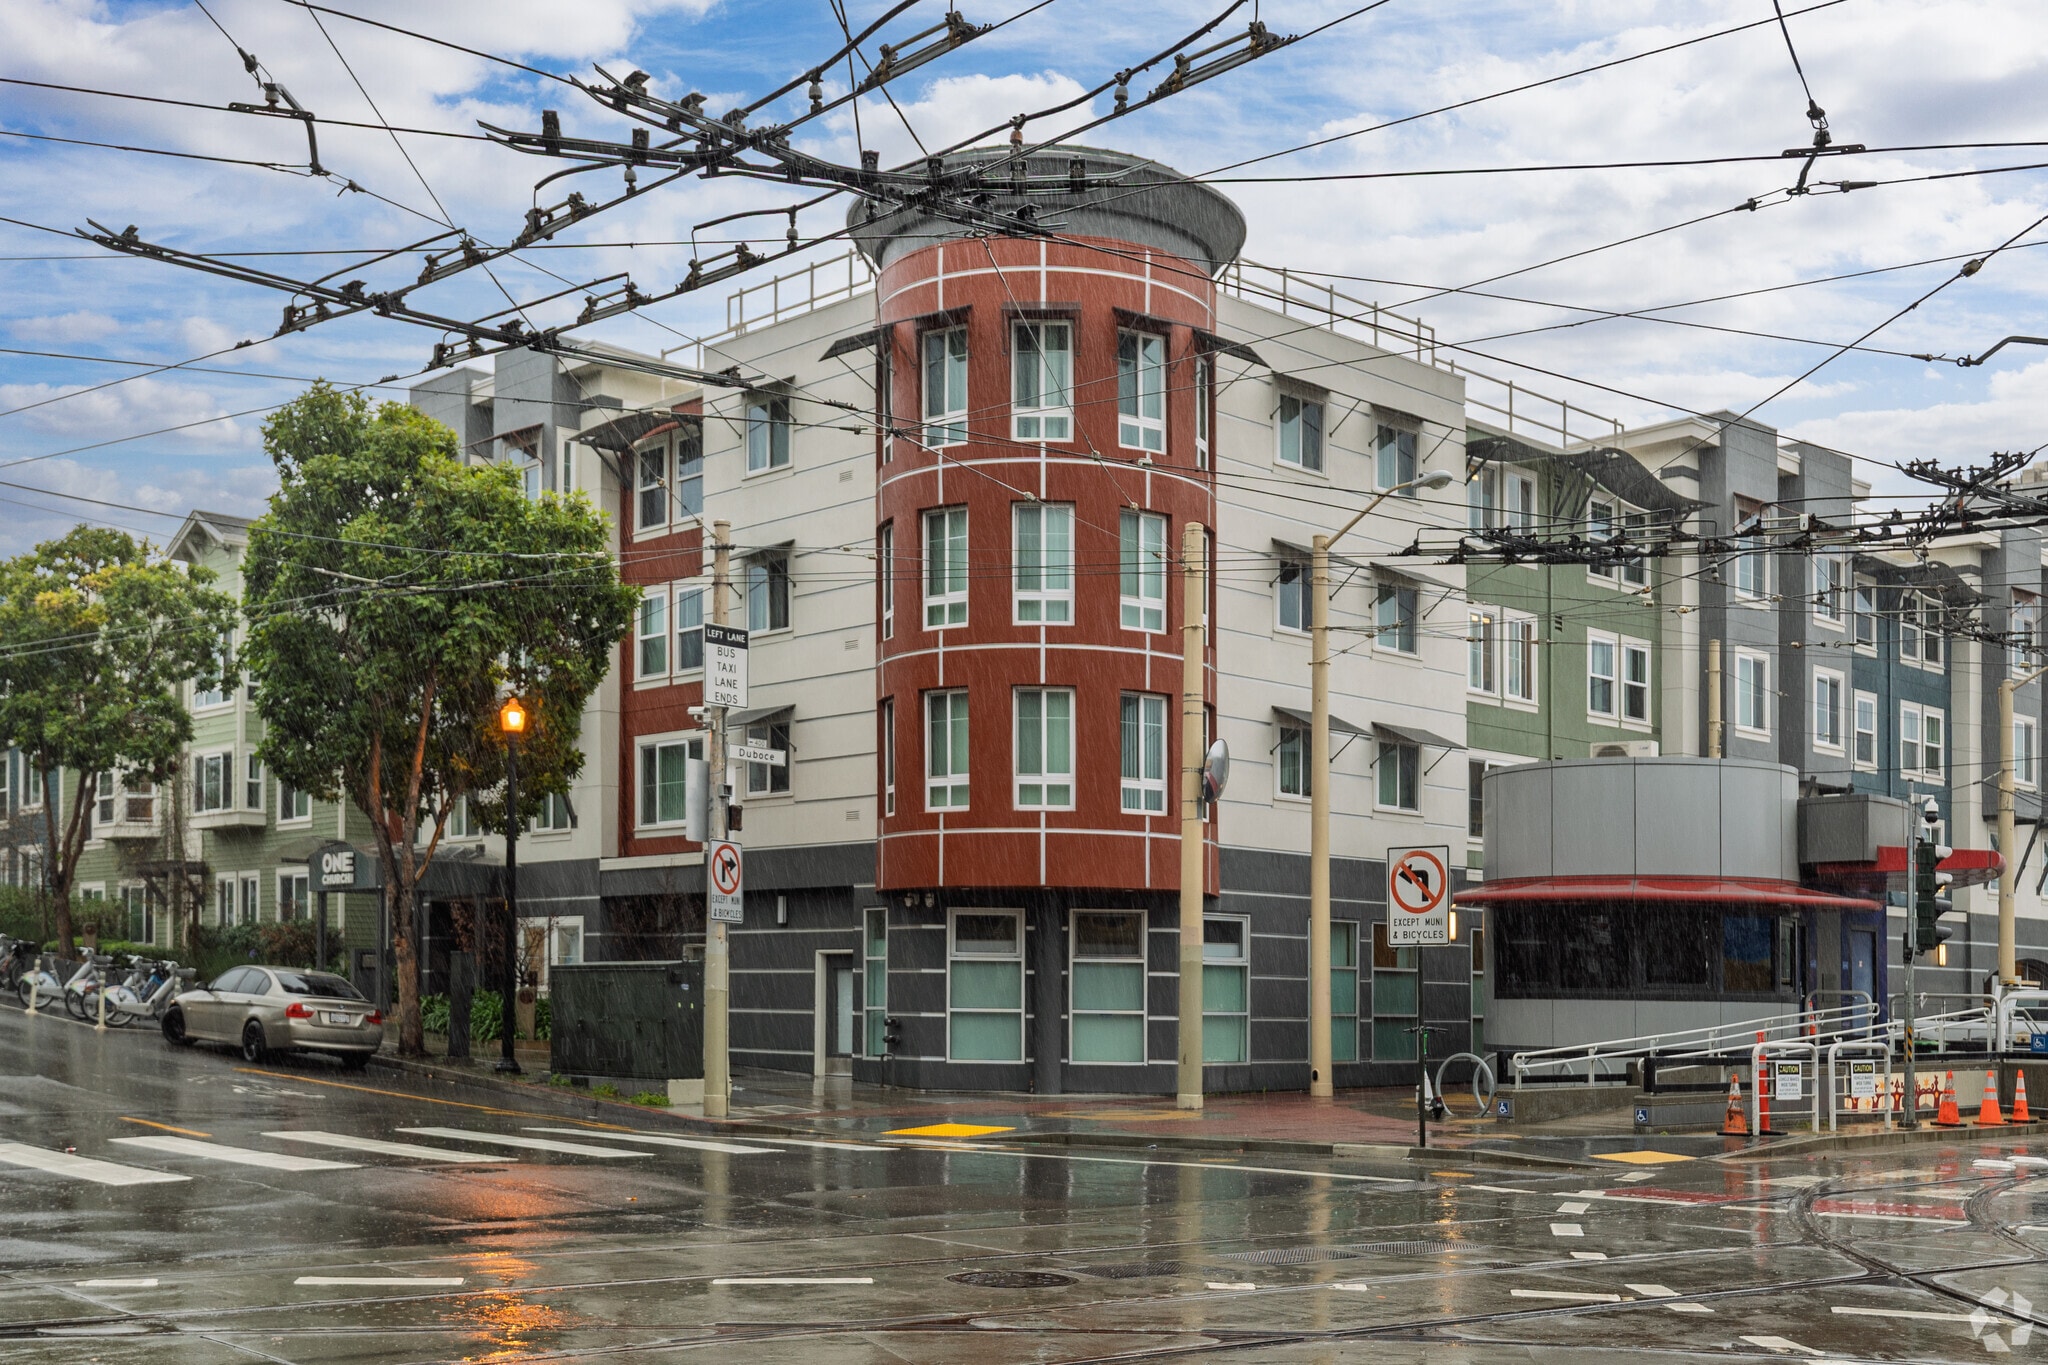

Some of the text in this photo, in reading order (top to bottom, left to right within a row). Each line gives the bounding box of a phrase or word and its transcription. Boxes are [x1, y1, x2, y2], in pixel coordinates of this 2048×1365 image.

[707, 628, 746, 643] LEFT LANE
[717, 646, 736, 659] BUS
[717, 661, 737, 674] TAXI
[715, 677, 738, 690] LANE
[715, 692, 738, 704] ENDS
[739, 748, 775, 761] Duboce
[321, 851, 355, 873] ONE
[712, 894, 728, 904] EXCEPT
[718, 908, 743, 919] BICYCLES
[1393, 917, 1443, 927] EXCEPT MUNI
[1393, 930, 1444, 939] & BICYCLES
[1854, 1064, 1873, 1072] CAUTION
